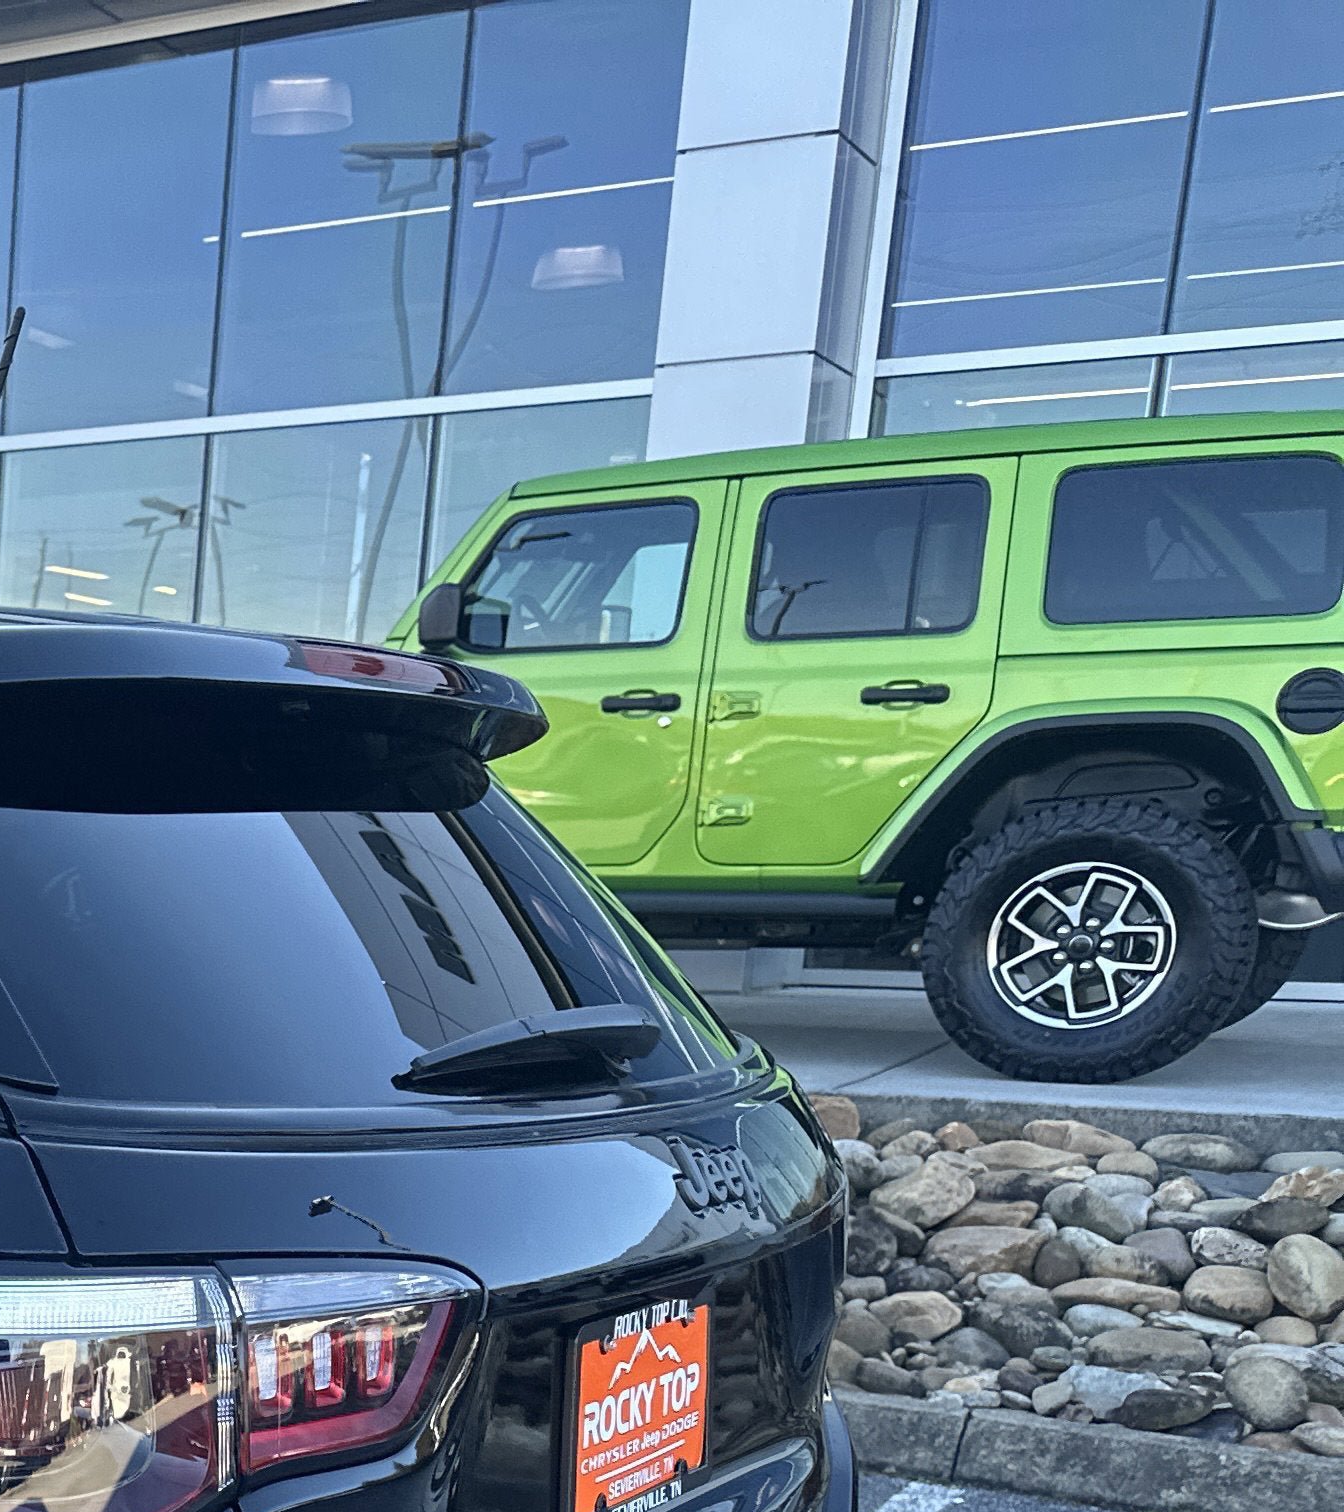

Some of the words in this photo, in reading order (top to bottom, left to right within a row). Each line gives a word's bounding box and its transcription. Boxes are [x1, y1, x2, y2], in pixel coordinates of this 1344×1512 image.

[666, 1136, 762, 1216] Jeep
[614, 1307, 649, 1339] ROCKY
[651, 1301, 669, 1329] TOP
[582, 1378, 655, 1449] ROCKY
[660, 1362, 700, 1416] TOP
[580, 1439, 639, 1474] CHRYSLER
[641, 1429, 661, 1451] Jeep
[662, 1411, 699, 1440] DODGE
[663, 1456, 674, 1475] TN
[670, 1480, 682, 1499] TN
